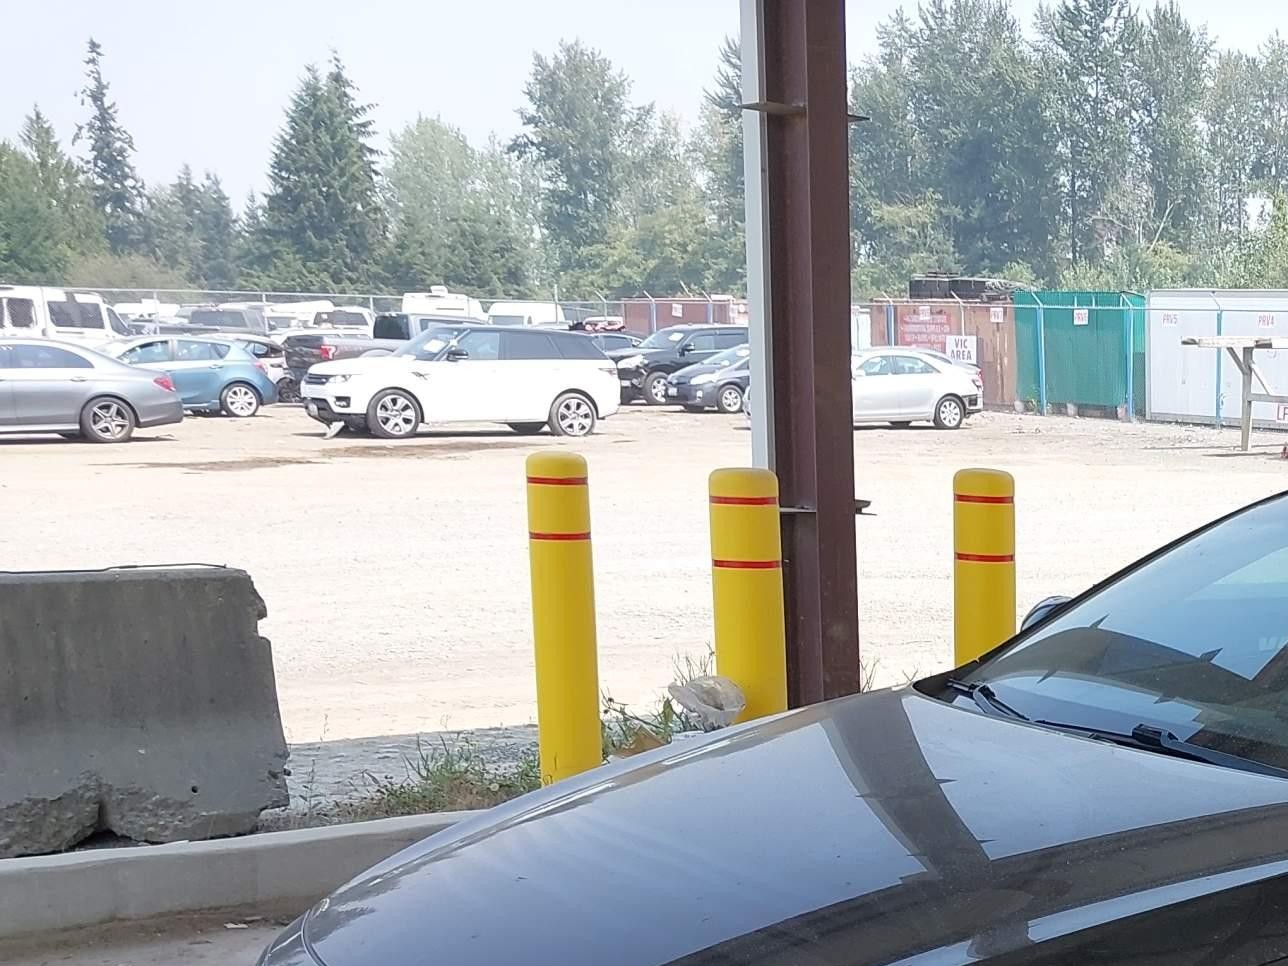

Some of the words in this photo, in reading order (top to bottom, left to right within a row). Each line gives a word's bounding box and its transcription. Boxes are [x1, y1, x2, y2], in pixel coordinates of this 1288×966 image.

[1258, 313, 1275, 327] PRV4
[954, 337, 968, 349] VIC
[950, 349, 972, 361] AREA
